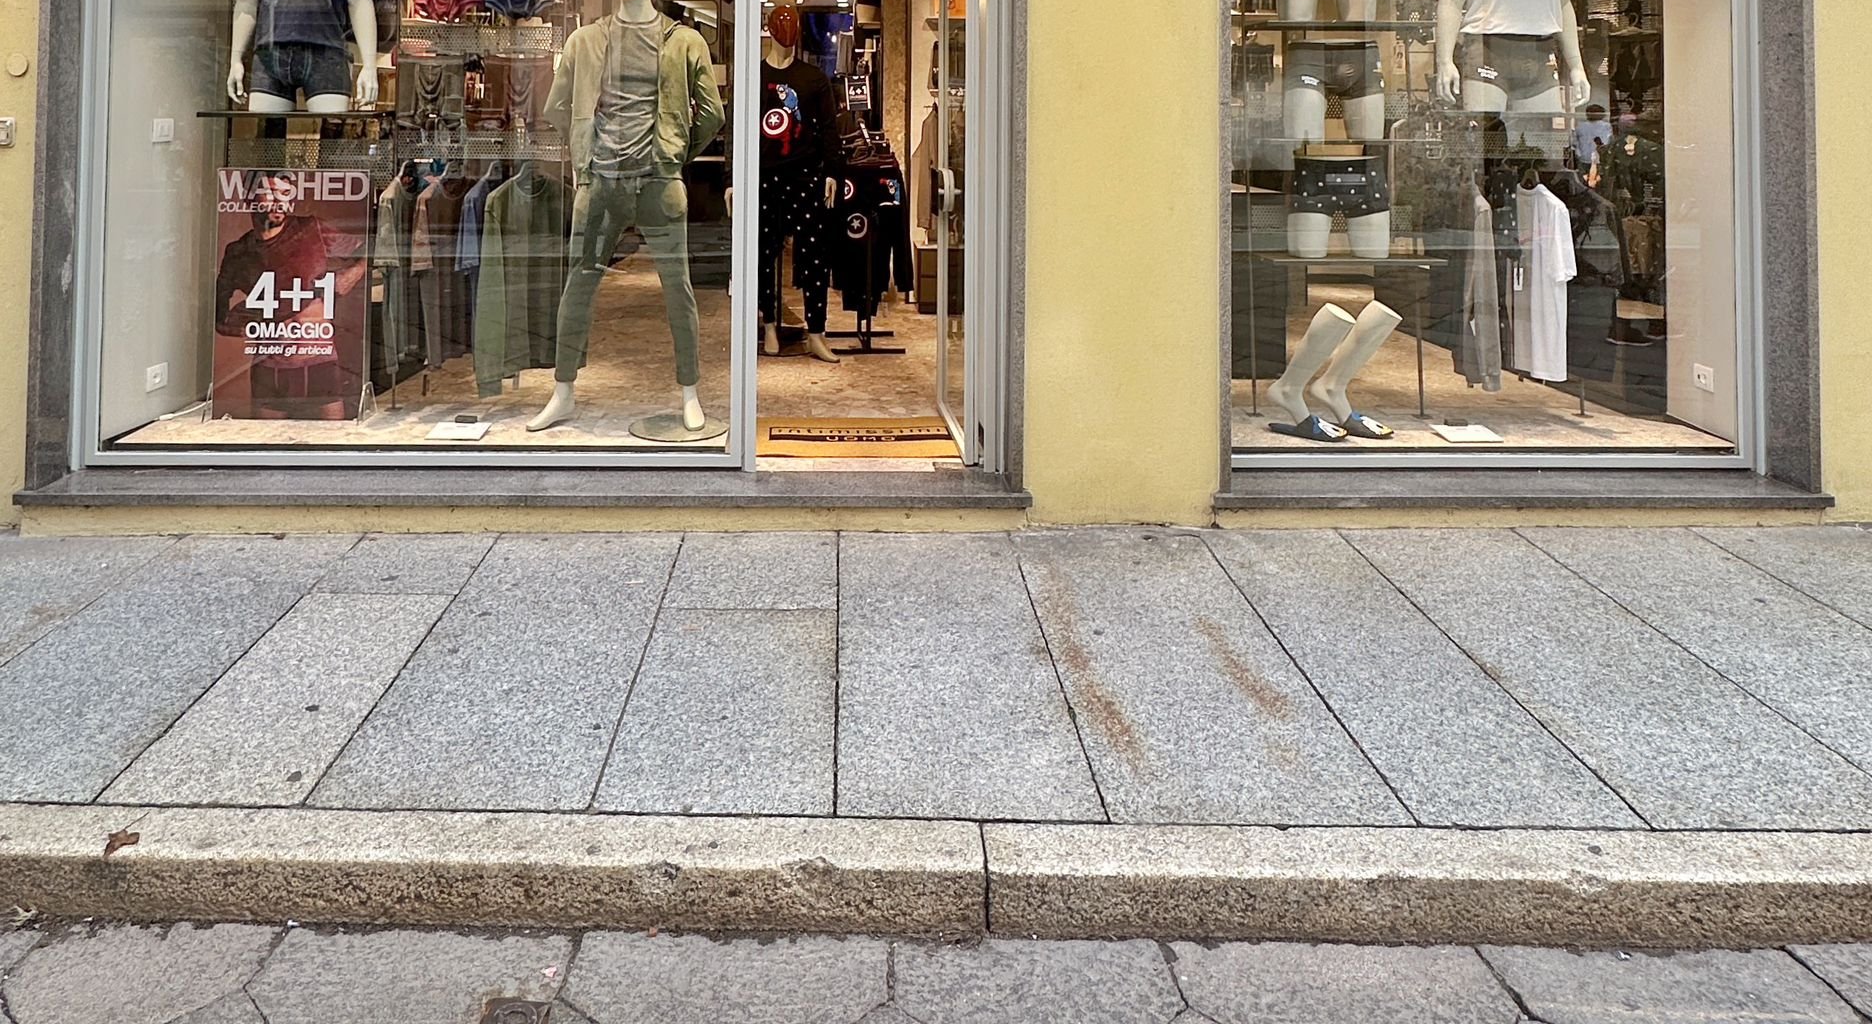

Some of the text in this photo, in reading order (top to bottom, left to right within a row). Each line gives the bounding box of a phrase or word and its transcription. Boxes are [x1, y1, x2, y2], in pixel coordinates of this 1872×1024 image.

[219, 170, 370, 202] WASHED
[218, 201, 295, 213] COLLECTION
[245, 271, 335, 320] 4+1
[245, 321, 334, 339] OMAGGIO
[244, 345, 333, 357] su tutti gli articoli
